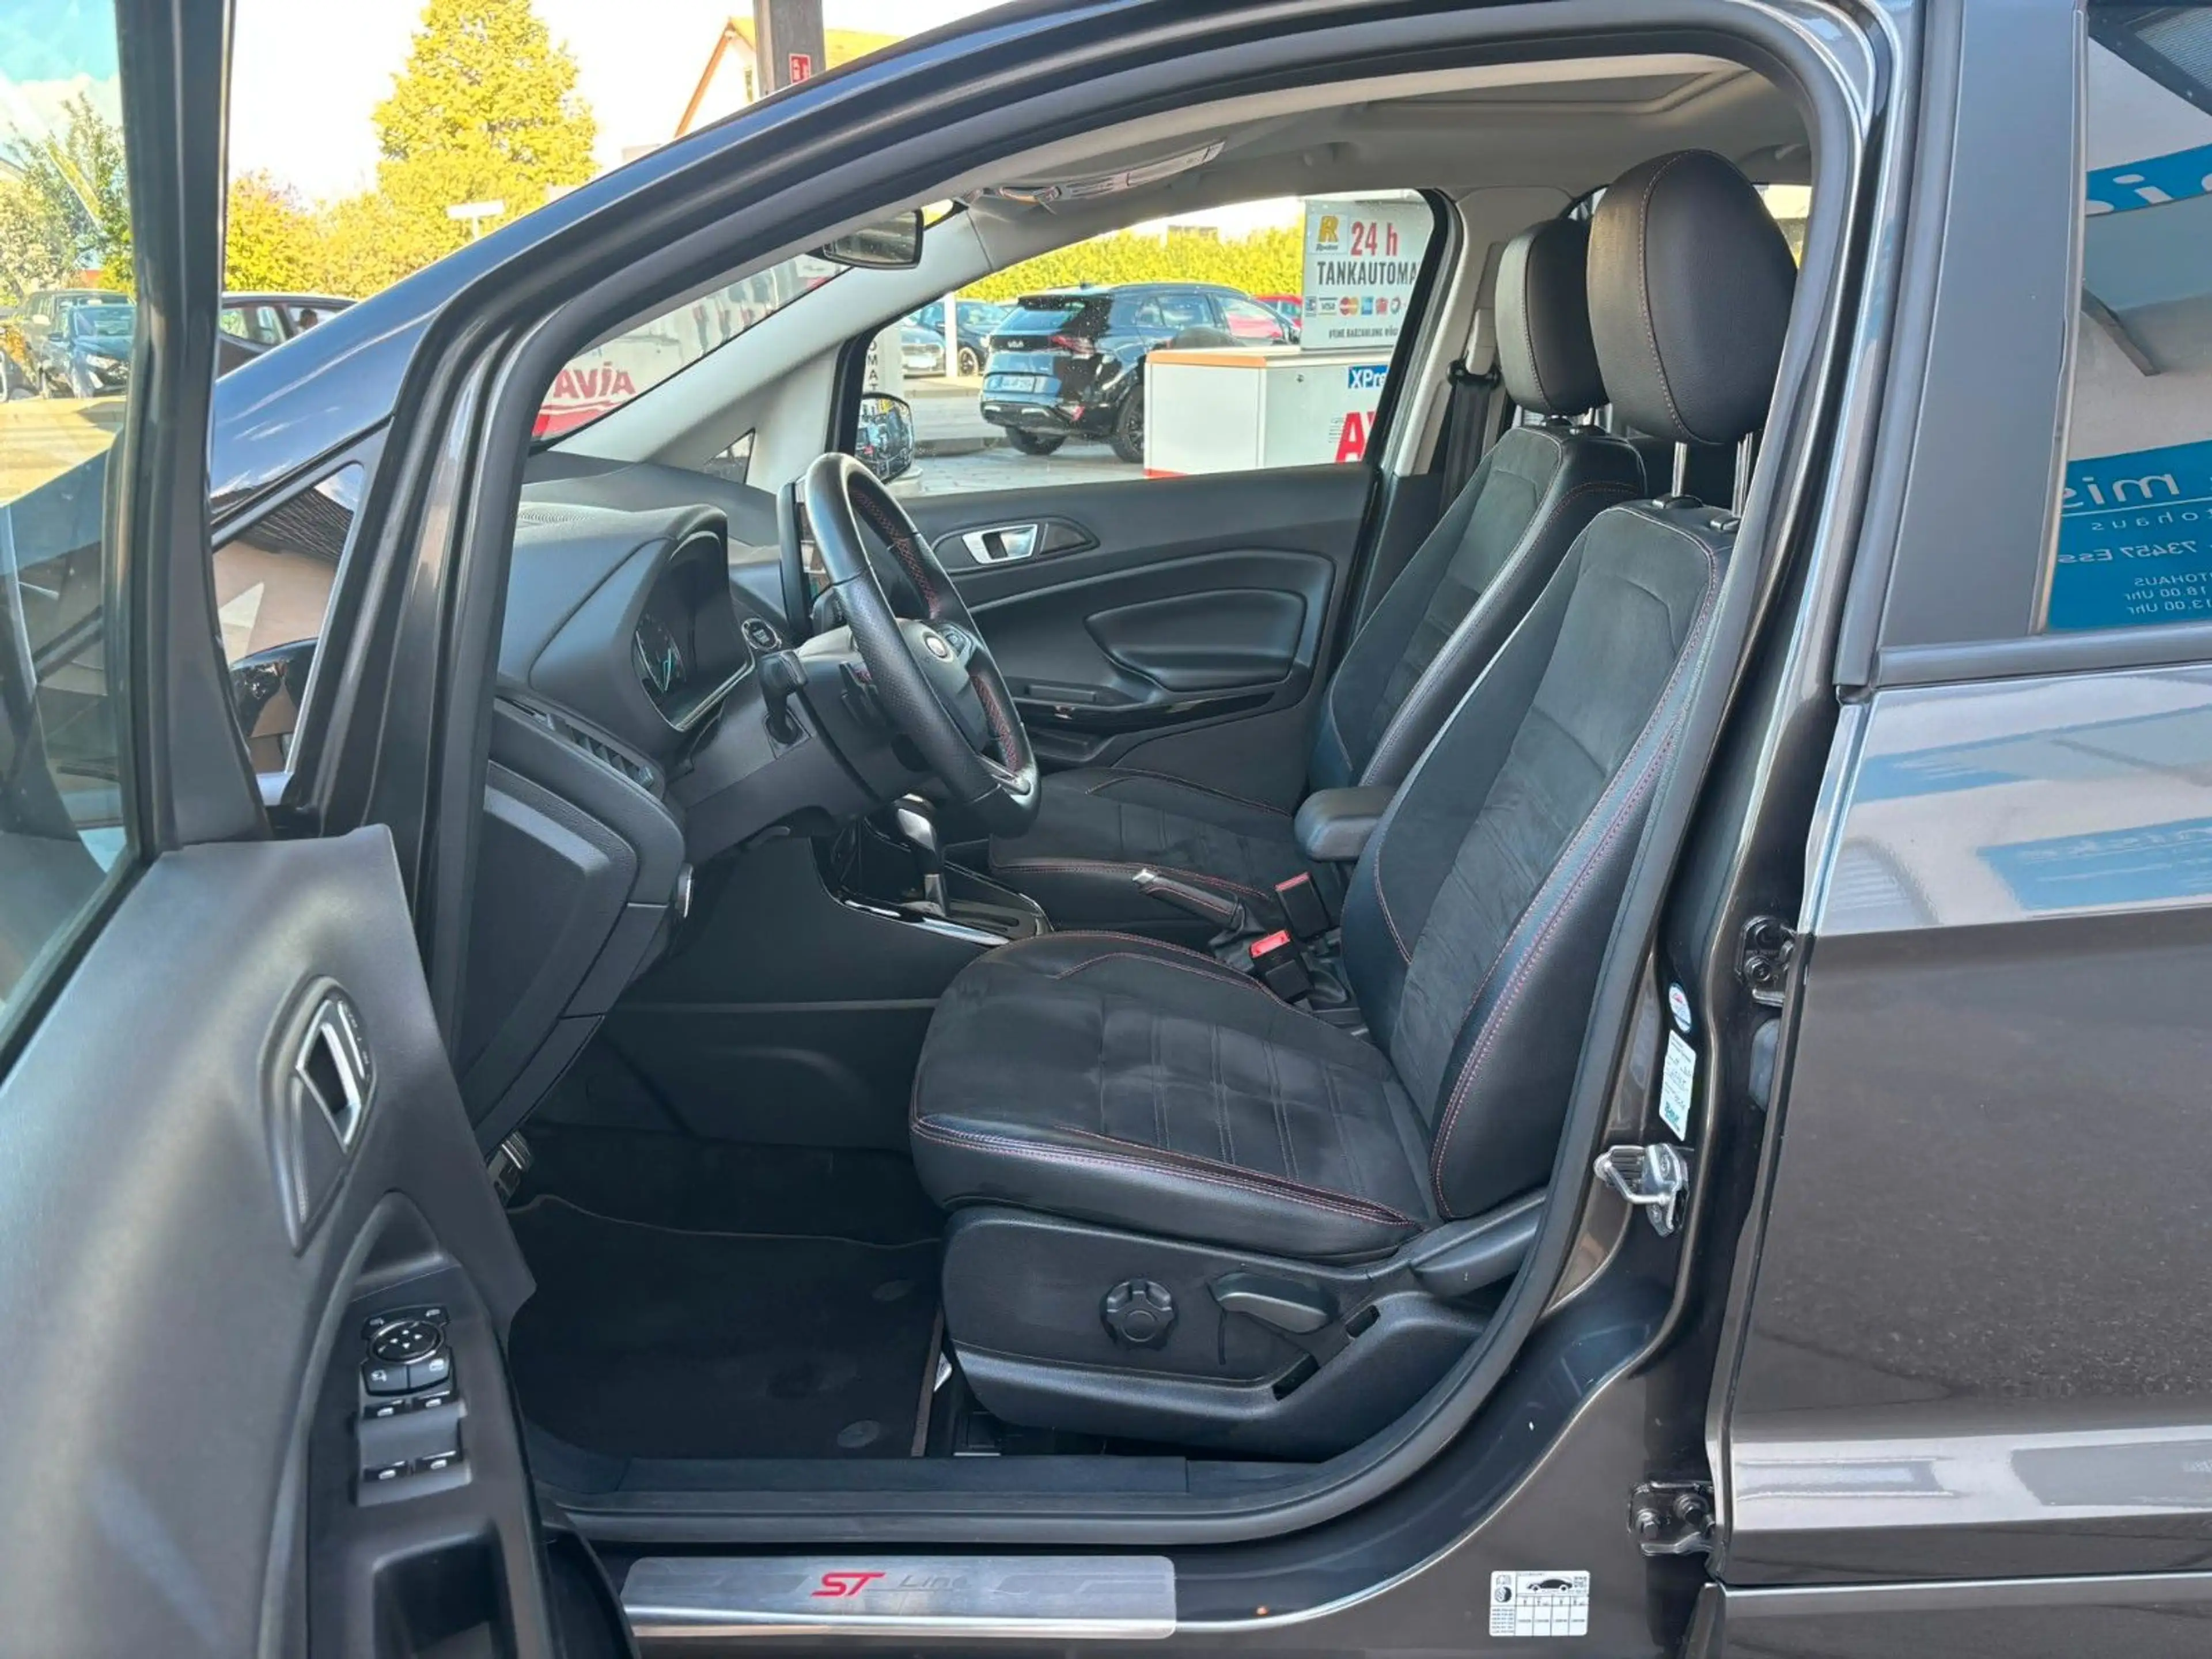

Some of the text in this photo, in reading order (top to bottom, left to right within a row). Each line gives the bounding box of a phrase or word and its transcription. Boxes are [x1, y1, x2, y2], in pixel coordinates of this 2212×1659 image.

[1350, 221, 1398, 256] 24 h
[810, 1572, 887, 1597] ST
